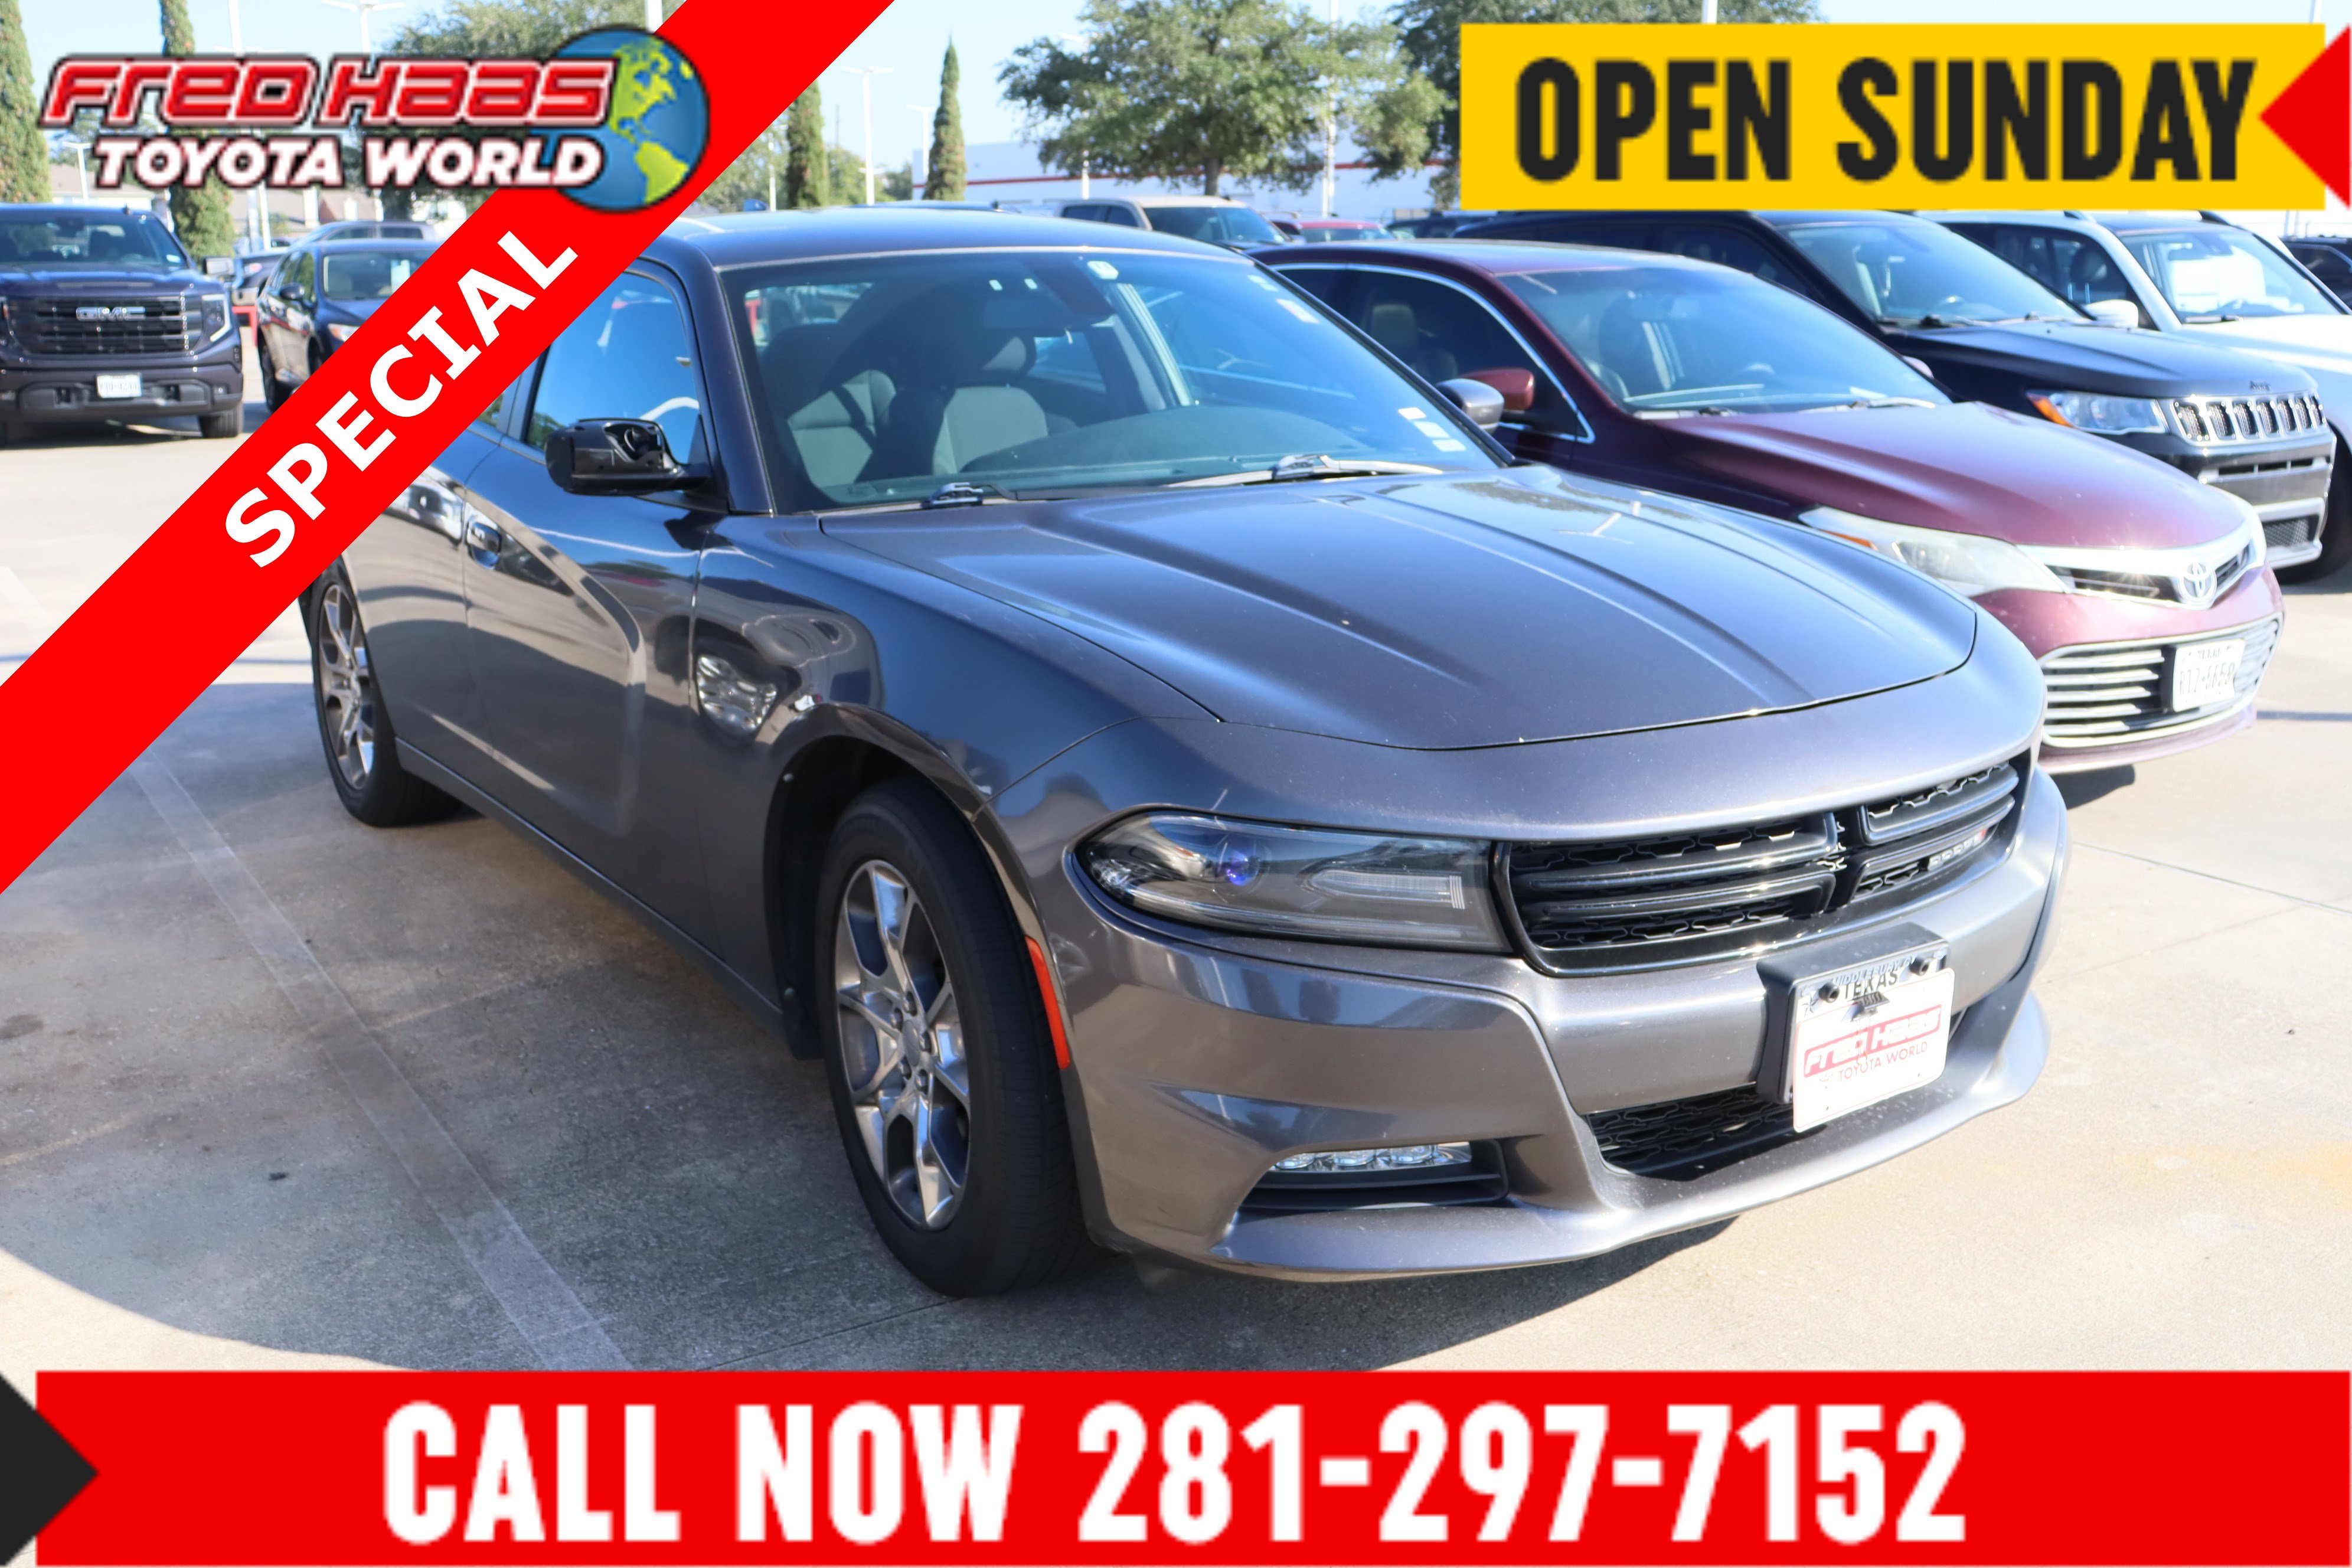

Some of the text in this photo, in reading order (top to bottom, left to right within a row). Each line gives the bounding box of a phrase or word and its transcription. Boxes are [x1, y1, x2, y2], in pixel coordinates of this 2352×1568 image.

[76, 306, 146, 321] GMC
[1845, 971, 1899, 999] TEXAS
[1838, 1041, 1928, 1082] TOYOTA WORLD
